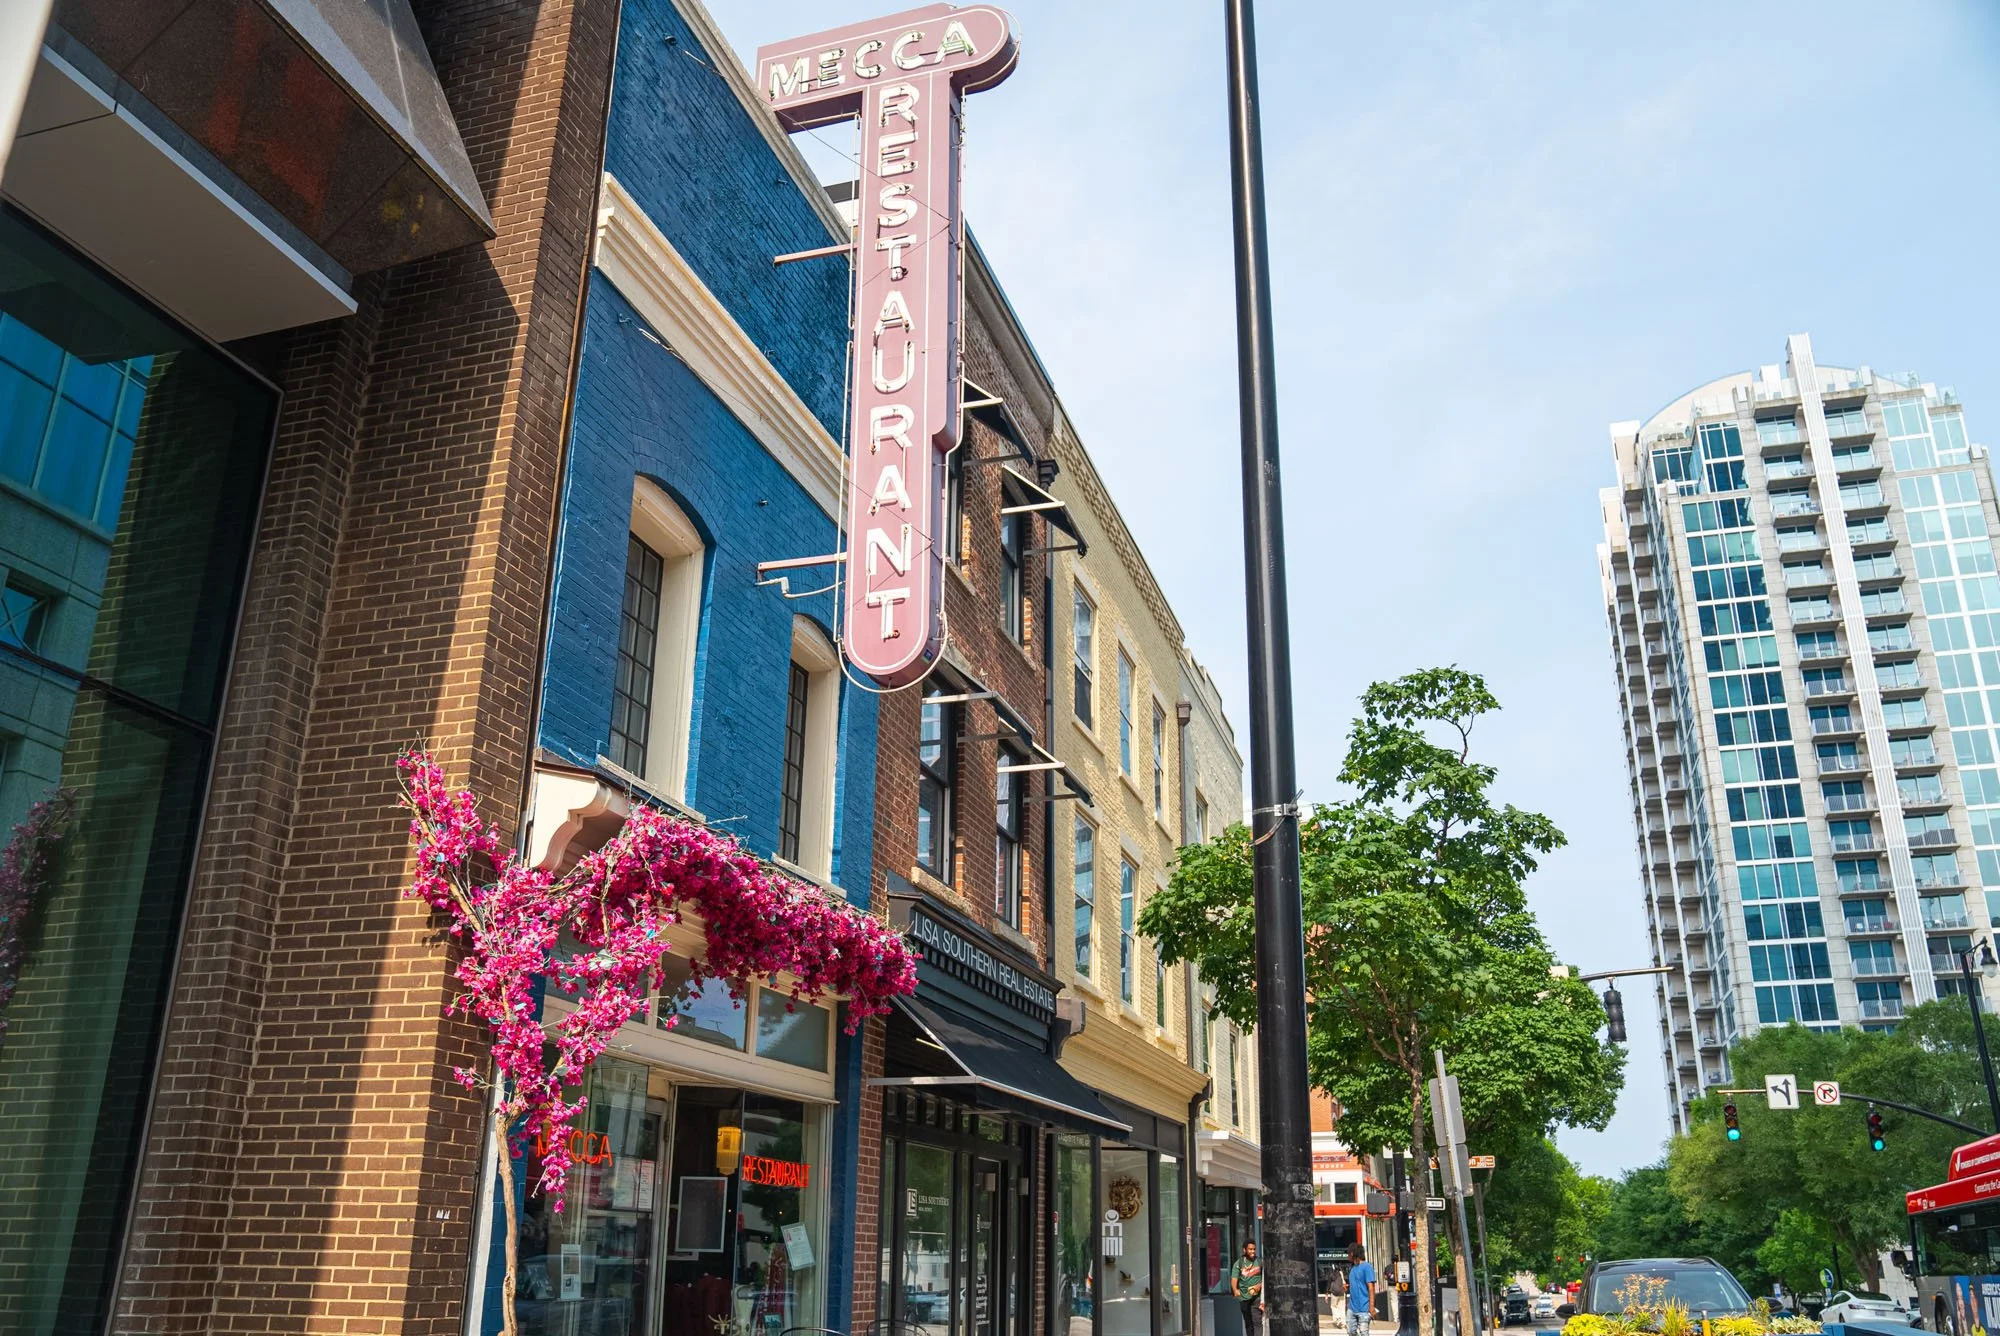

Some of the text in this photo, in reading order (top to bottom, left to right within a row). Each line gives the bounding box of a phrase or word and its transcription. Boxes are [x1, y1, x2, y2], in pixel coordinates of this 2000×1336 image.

[770, 20, 978, 101] MECCA
[866, 82, 921, 640] RESTAURANT
[914, 912, 1054, 1010] LISA SOUTHERN REAL ESTATE
[535, 1126, 614, 1167] MCCA
[742, 1154, 811, 1188] RESTAURANT
